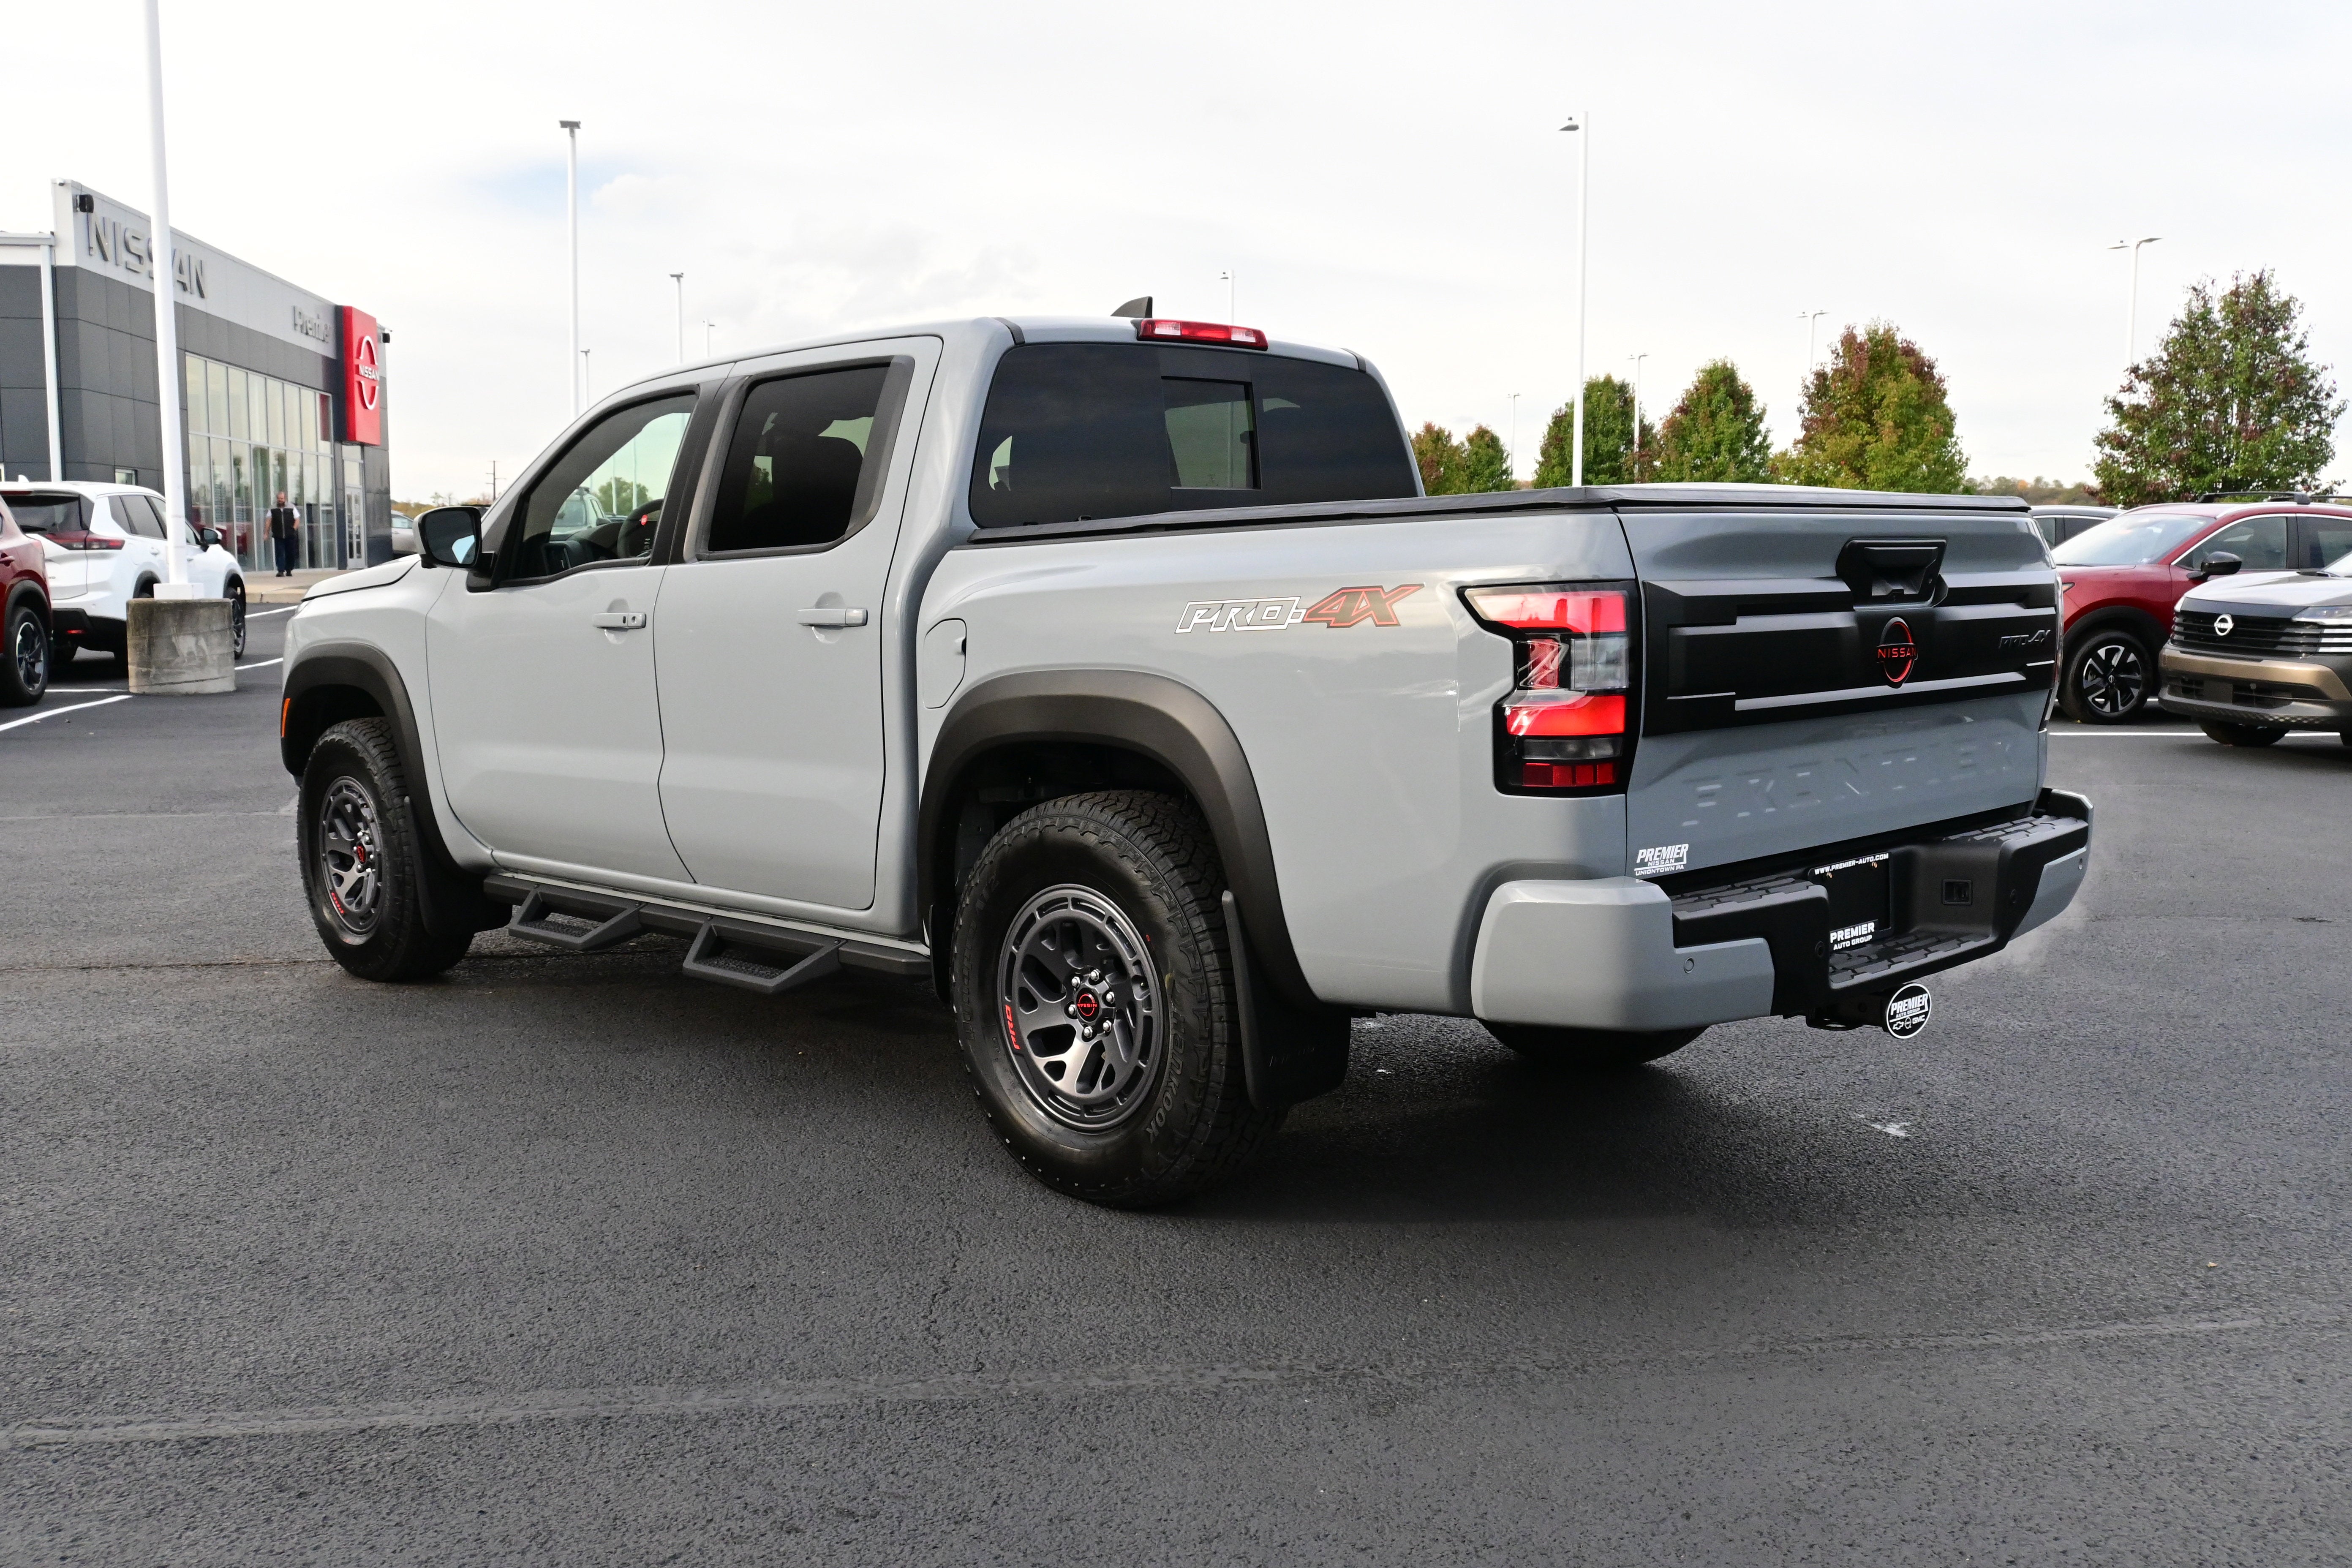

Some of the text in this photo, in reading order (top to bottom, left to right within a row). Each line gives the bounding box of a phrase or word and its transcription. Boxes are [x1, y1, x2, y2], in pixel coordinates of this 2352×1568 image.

[87, 212, 208, 299] NISAN
[359, 365, 379, 381] NISSAN
[1878, 647, 1916, 658] NISSAN
[1636, 844, 1689, 863] PREMIER
[1648, 858, 1675, 866] NISSAN
[1814, 853, 1889, 875] WWW.PREMIER-AUTO.COM
[1635, 866, 1675, 876] UNIONTOWN
[1830, 922, 1875, 943] PREMIER
[1833, 935, 1872, 950] AUTO GROUP
[1890, 993, 1928, 1015] PREMIER
[1912, 1015, 1925, 1024] GMC
